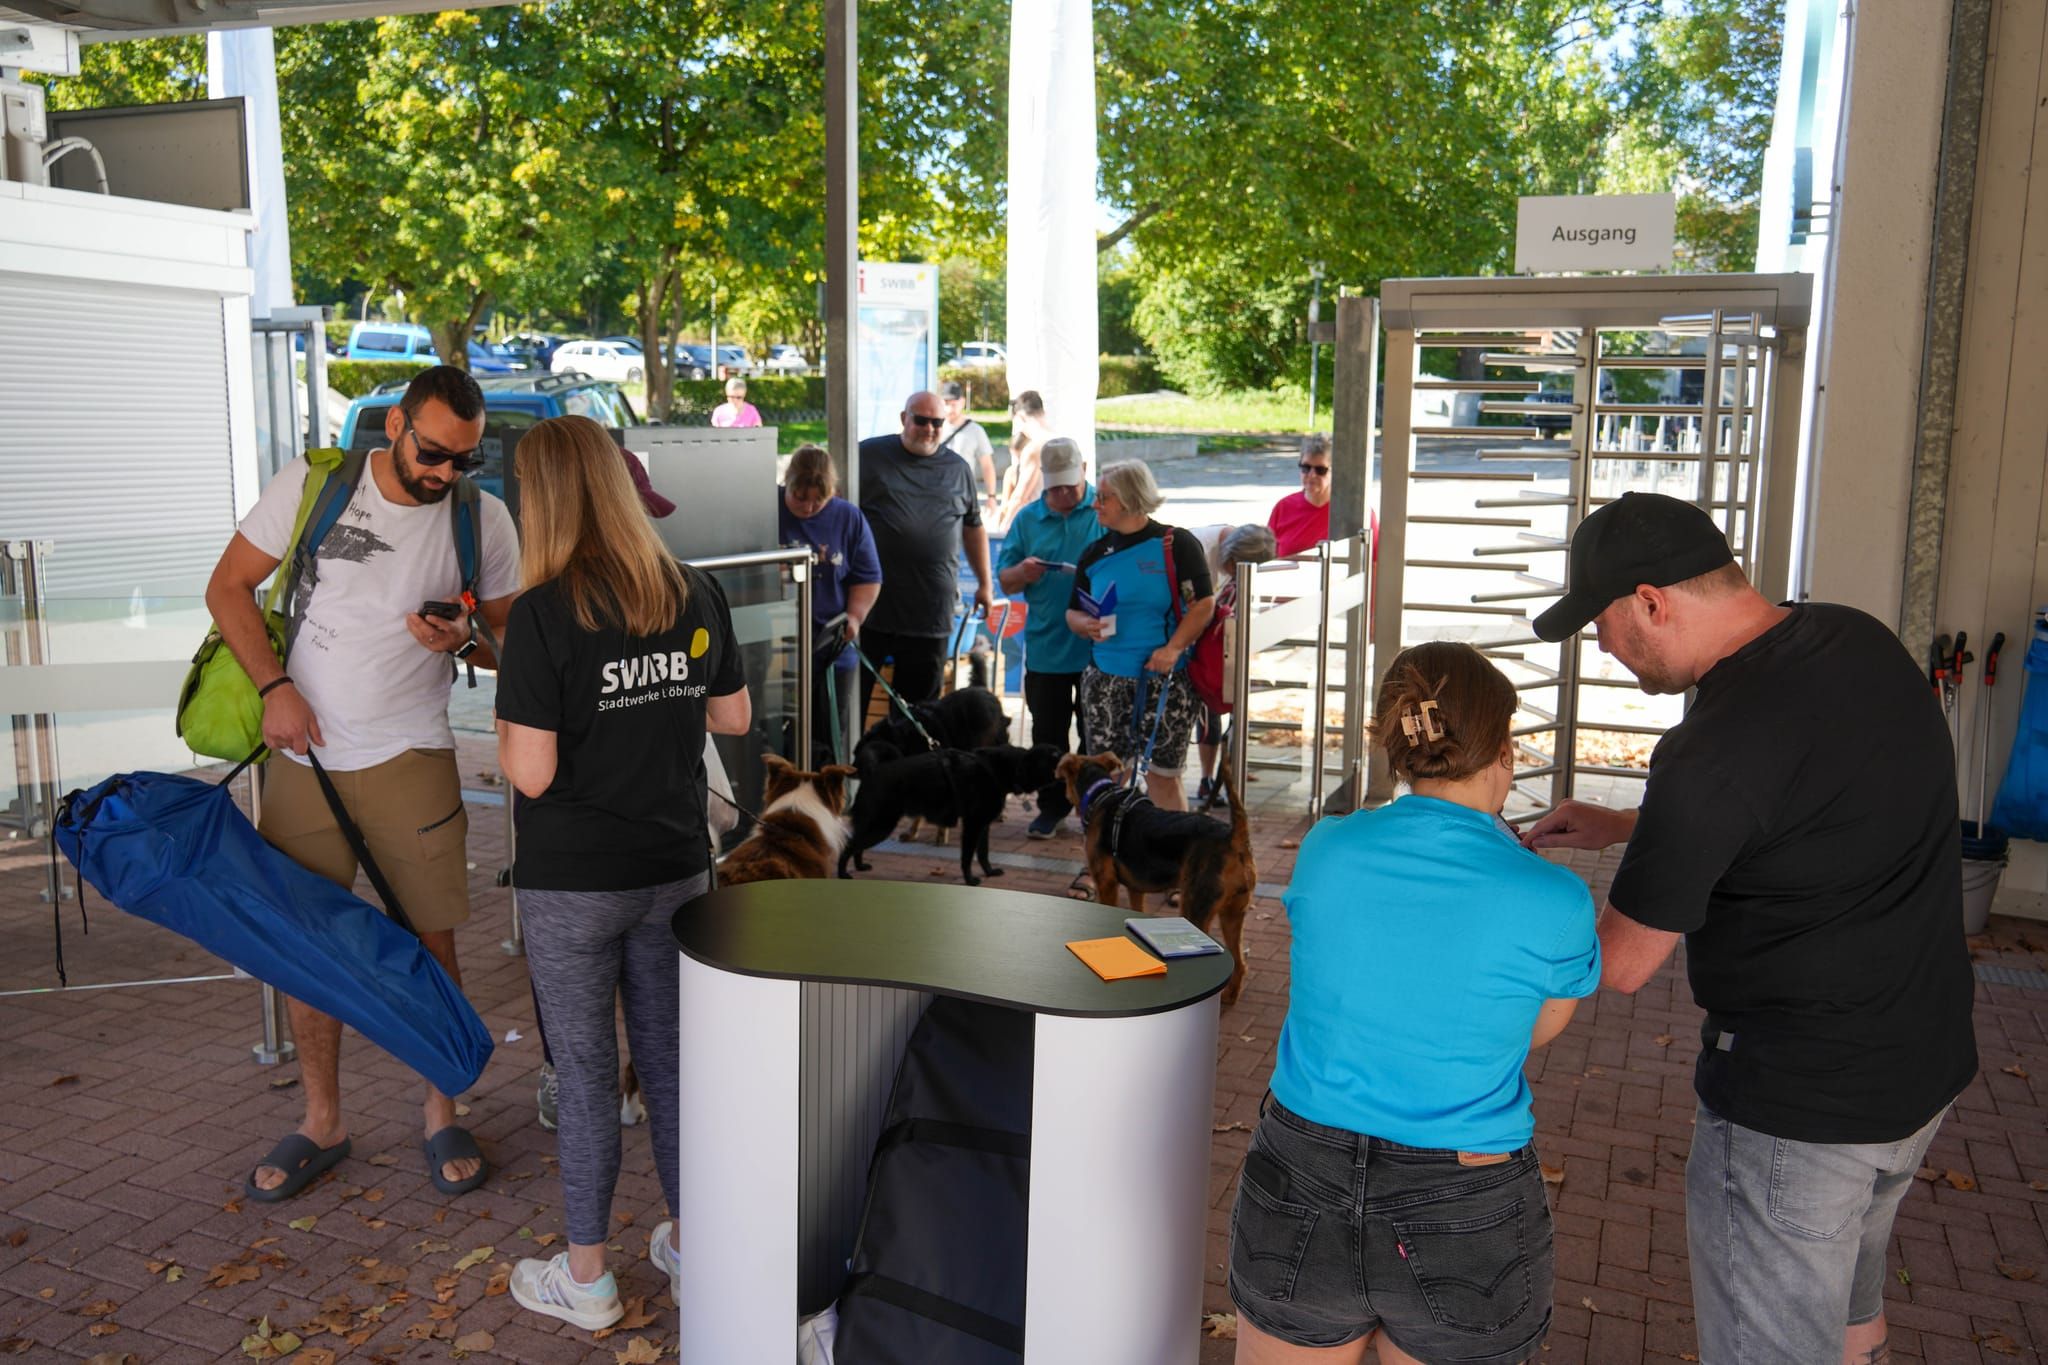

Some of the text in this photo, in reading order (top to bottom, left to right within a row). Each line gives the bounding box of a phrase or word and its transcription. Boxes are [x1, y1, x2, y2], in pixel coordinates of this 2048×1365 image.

[1551, 225, 1636, 246] Ausgang
[348, 501, 372, 522] Hope
[601, 651, 689, 694] SWBB
[598, 690, 660, 711] Stadtwerke
